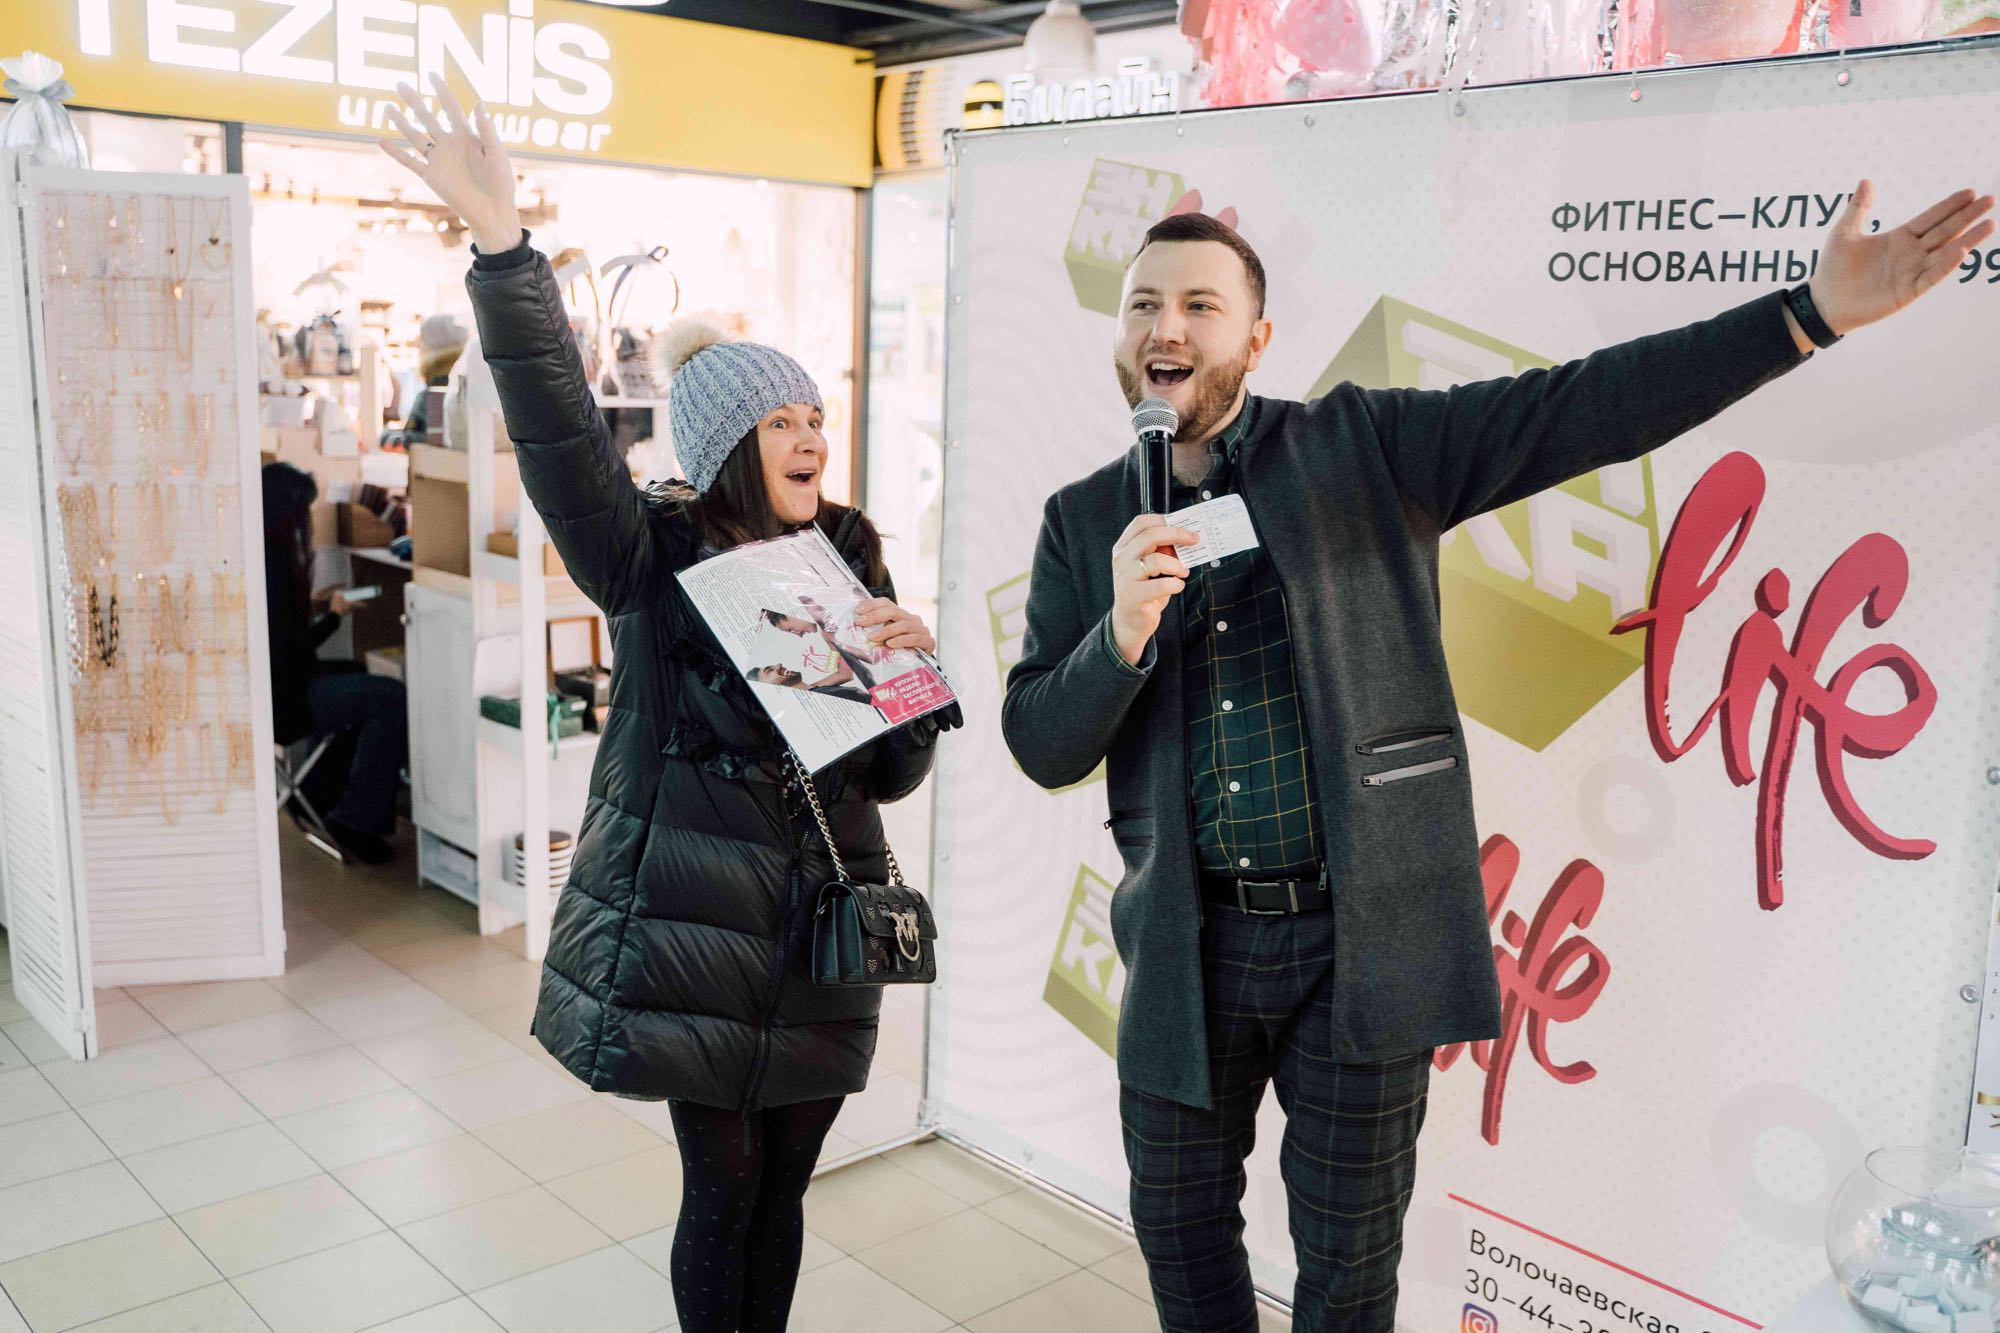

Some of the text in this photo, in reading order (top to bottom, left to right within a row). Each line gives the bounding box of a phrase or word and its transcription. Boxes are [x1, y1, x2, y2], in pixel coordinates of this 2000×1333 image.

[1551, 193, 1880, 232] ФИТНЕС–КЛУ,
[1548, 249, 1818, 283] ОСНОВАННЫ
[1609, 450, 1938, 911] life
